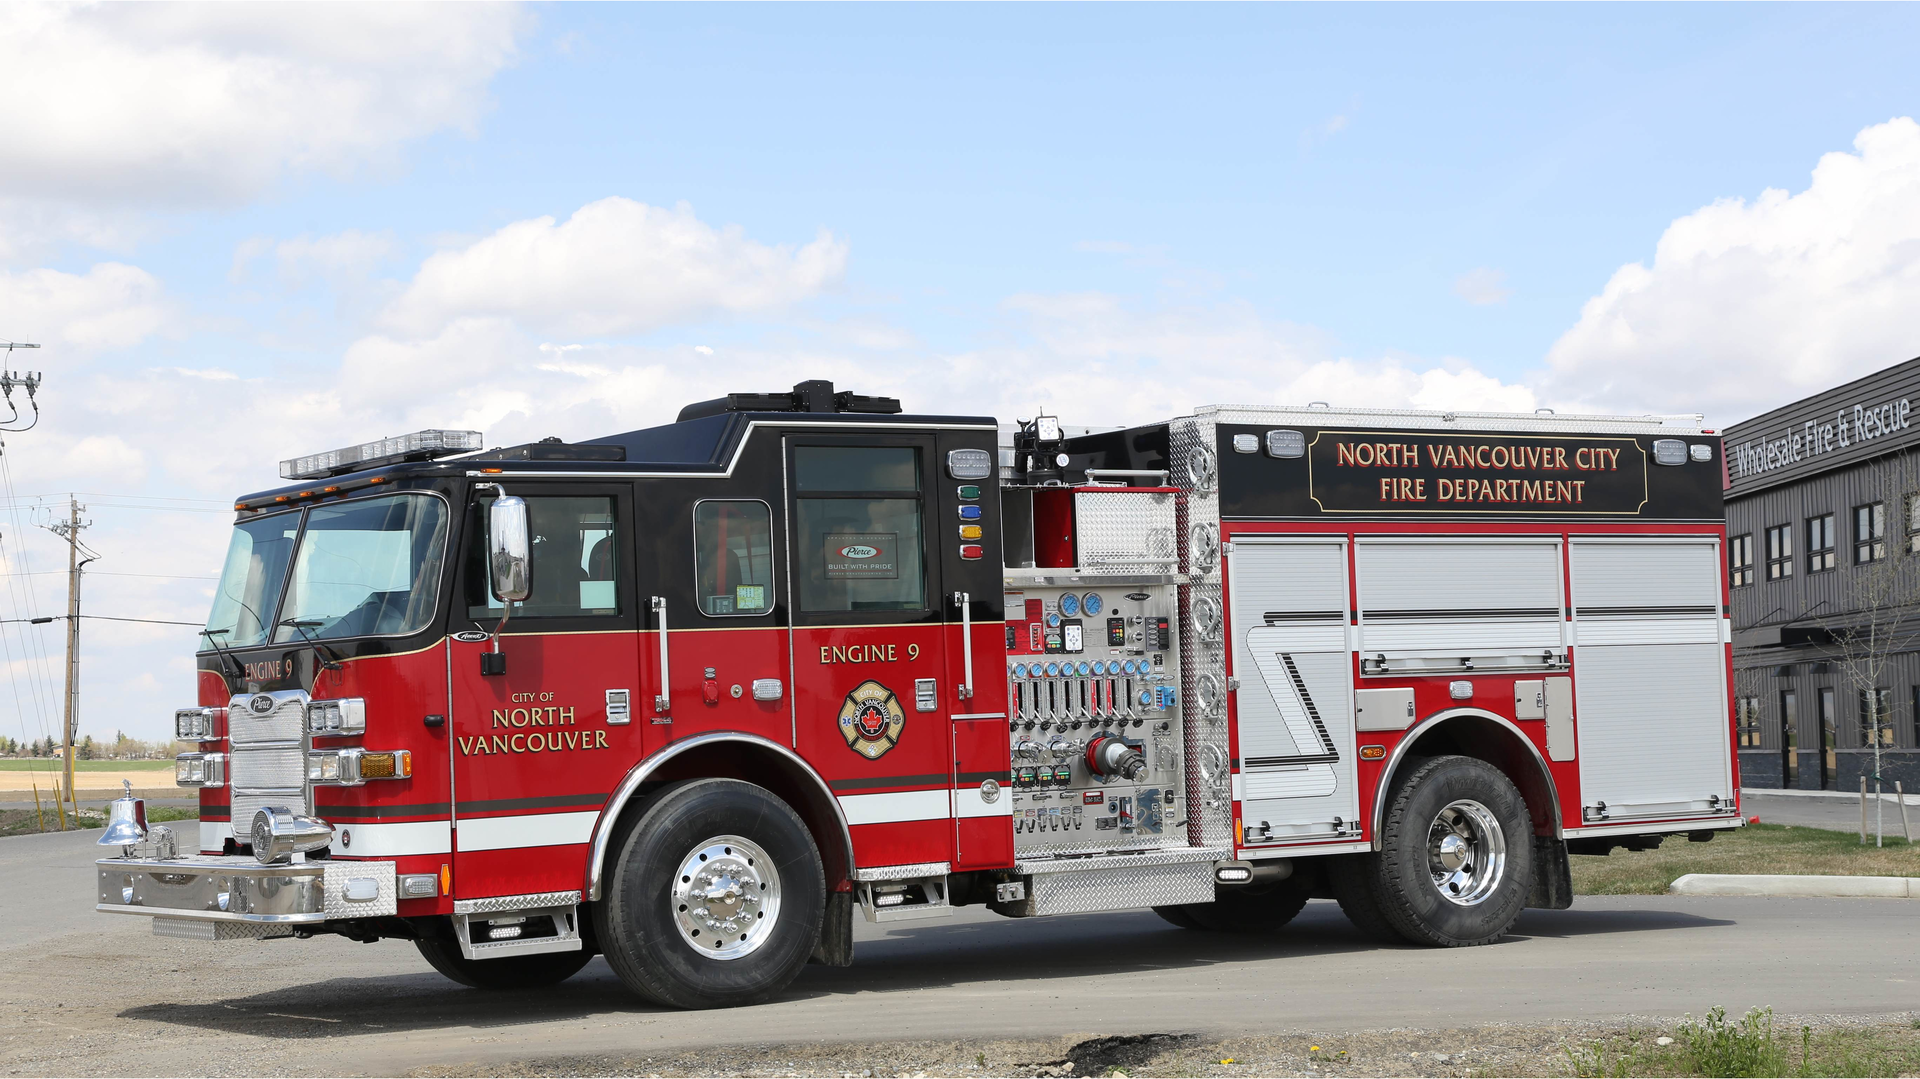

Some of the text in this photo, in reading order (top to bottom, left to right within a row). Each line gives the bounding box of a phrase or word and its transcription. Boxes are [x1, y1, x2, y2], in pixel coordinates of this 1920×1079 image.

[1736, 398, 1910, 478] Wholesale Fire & Rescue
[1336, 442, 1621, 471] NORTH VANCOUVER CITY
[1379, 477, 1585, 504] FIRE DEPARTMENT
[846, 546, 872, 557] Pierce
[820, 643, 920, 664] ENGINE 9
[244, 659, 293, 682] ENGINE 9
[511, 691, 554, 703] CITY OF
[491, 706, 575, 729] NORTH
[853, 699, 889, 724] NORTH VANCOUVER
[457, 730, 610, 756] VANCOUVER
